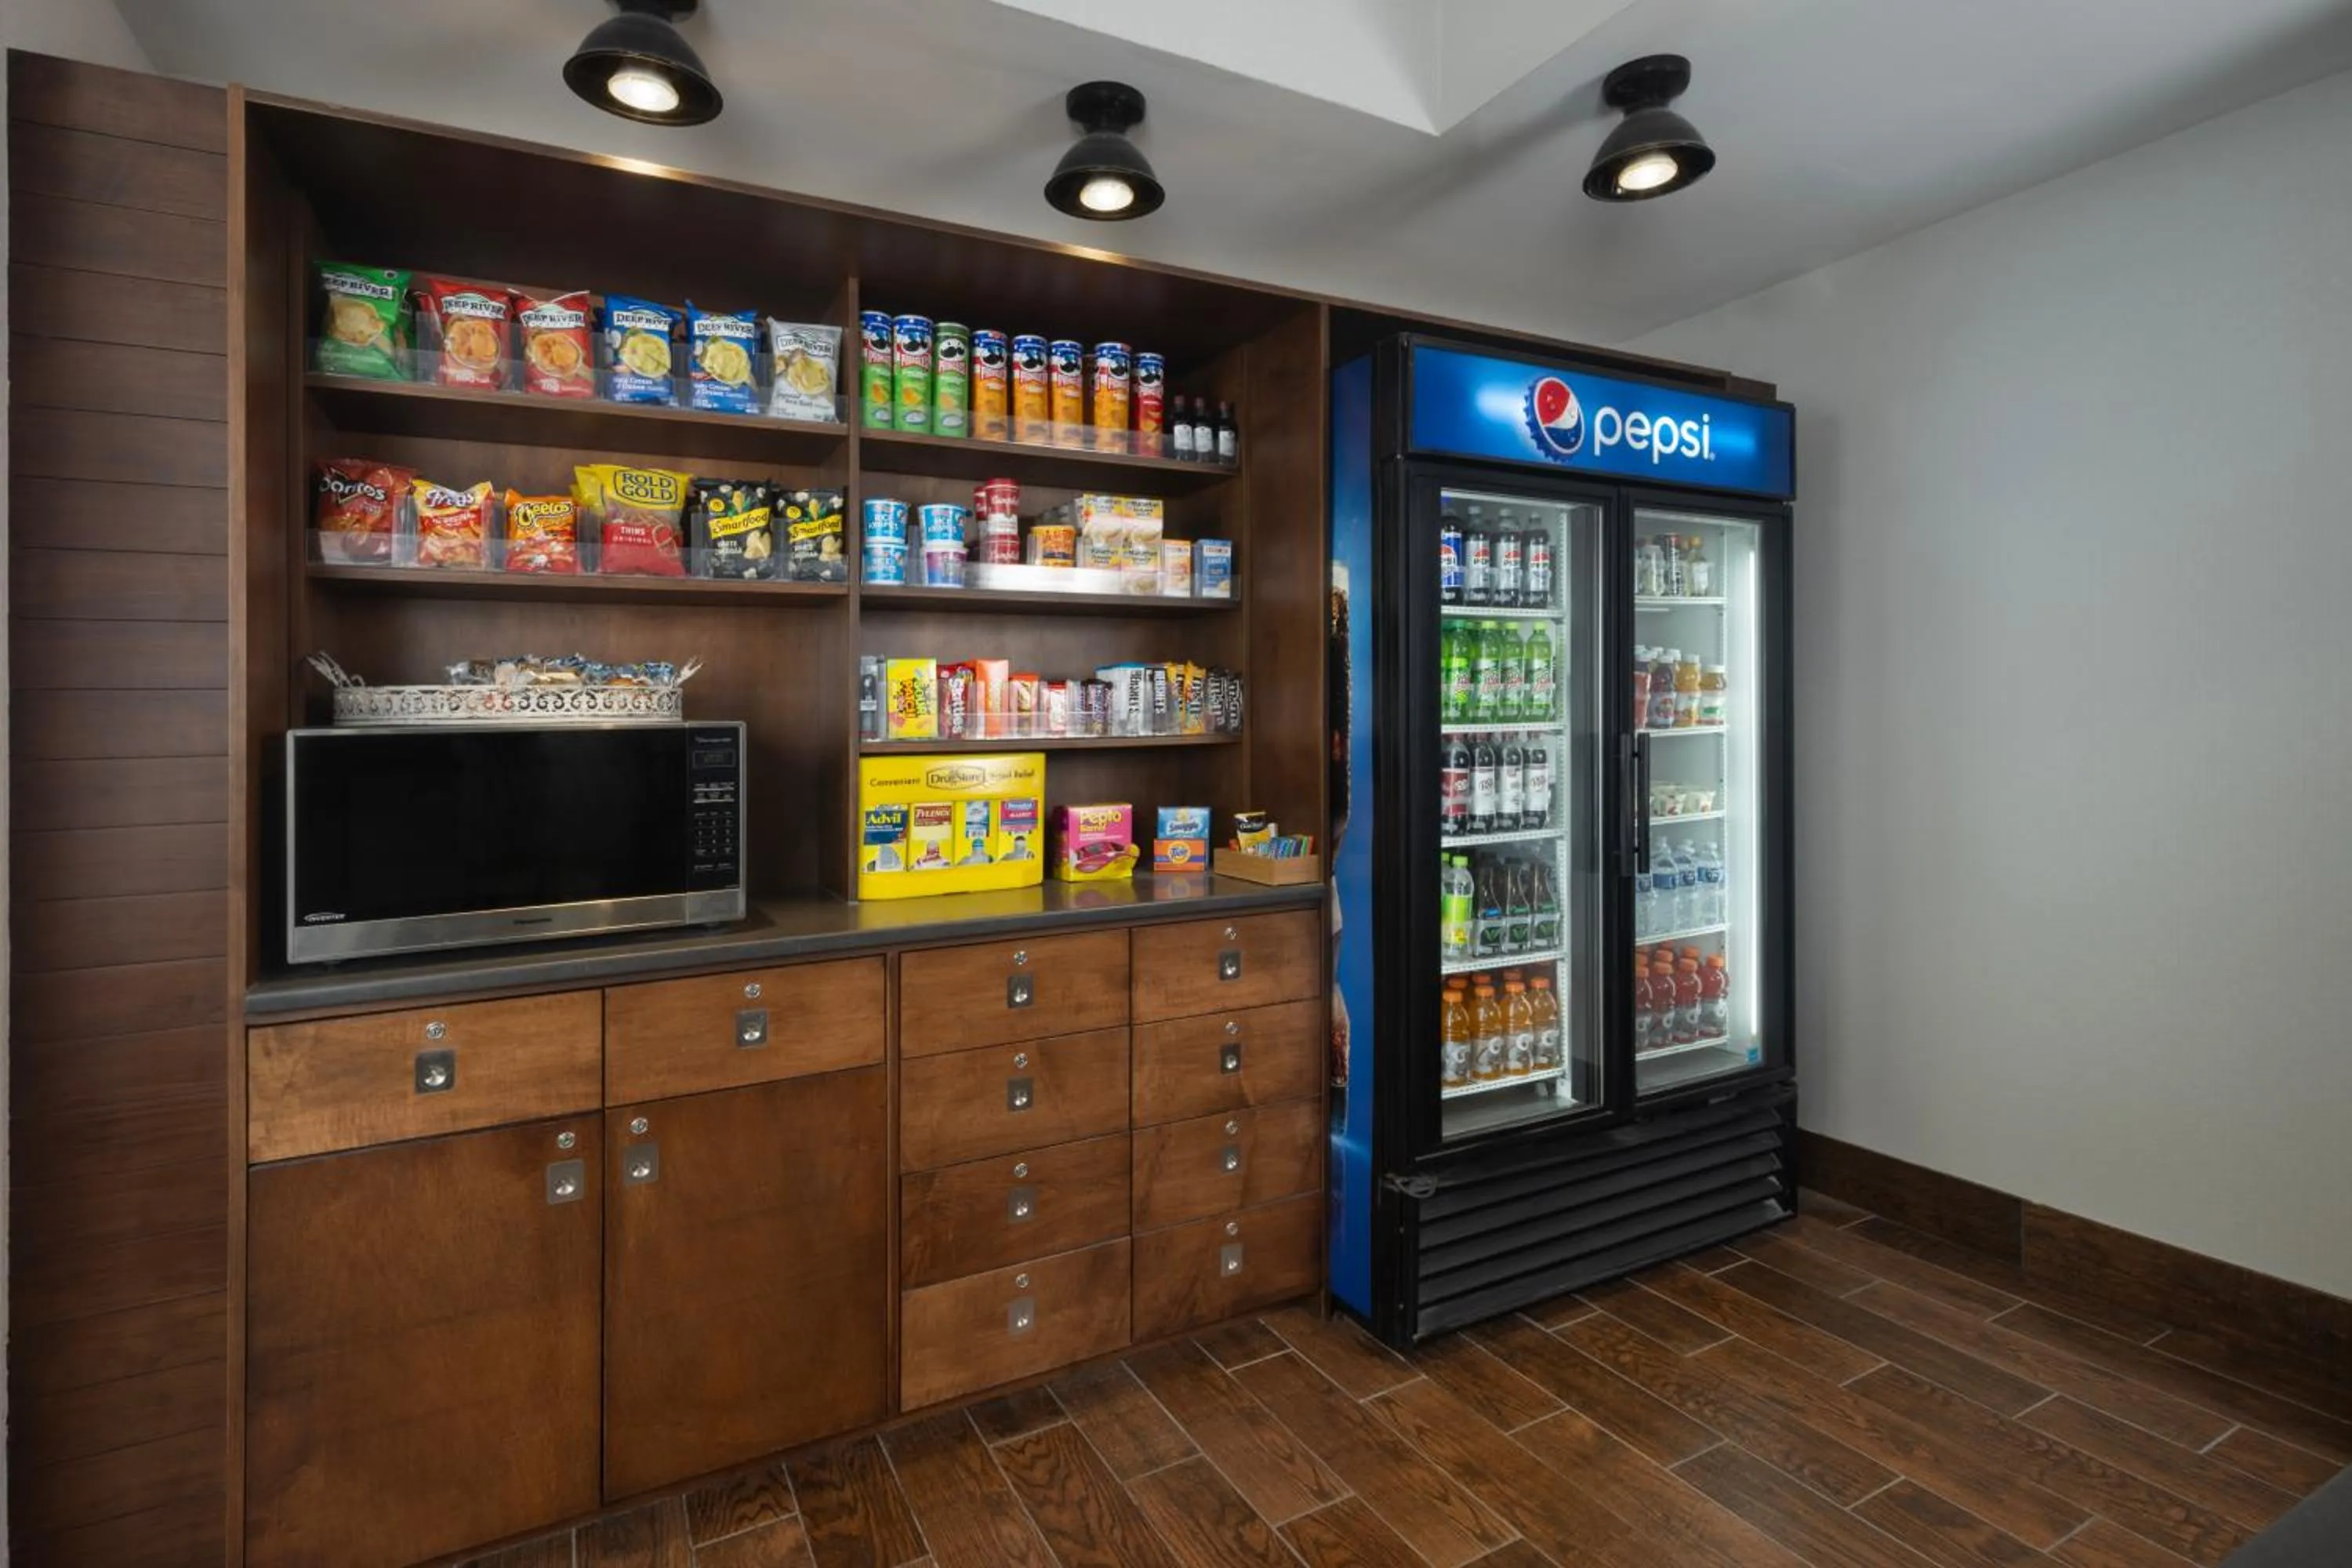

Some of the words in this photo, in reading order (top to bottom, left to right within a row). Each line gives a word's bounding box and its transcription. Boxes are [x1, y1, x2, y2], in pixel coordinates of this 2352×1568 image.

[616, 313, 645, 324] DEEP
[1593, 405, 1711, 465] pepsi
[621, 471, 672, 488] ROLD
[318, 477, 387, 502] Doritos
[621, 485, 673, 501] GOLD
[712, 511, 768, 534] Smartfood
[790, 520, 840, 539] Smartfood
[867, 811, 902, 825] Advil
[1079, 810, 1123, 826] Pepto
